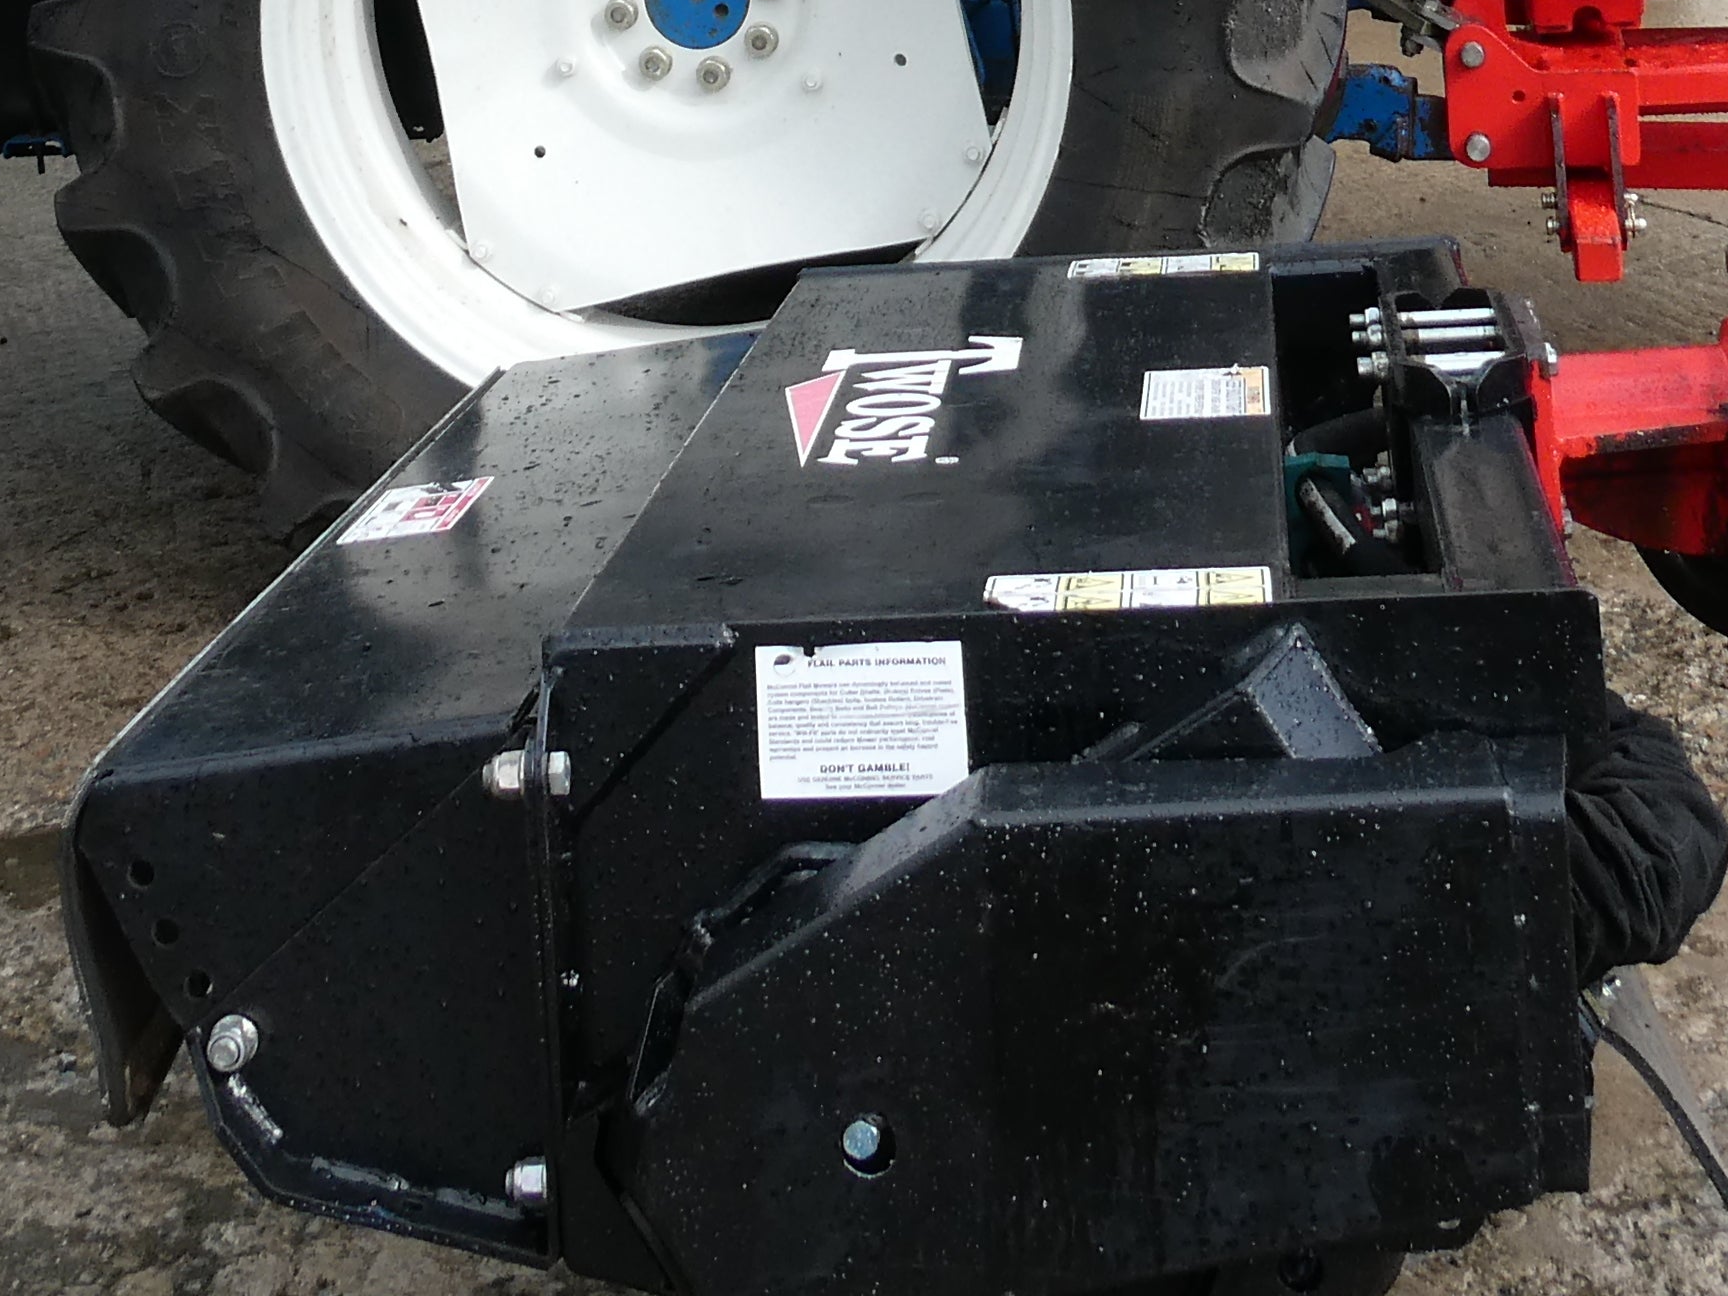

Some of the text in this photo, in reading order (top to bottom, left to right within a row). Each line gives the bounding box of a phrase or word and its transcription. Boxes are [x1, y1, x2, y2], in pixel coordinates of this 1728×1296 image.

[817, 333, 1024, 466] TWOSE
[808, 656, 947, 668] FLAIL PARTS INFORMATION
[819, 762, 910, 774] DON'T GAMBLE!
